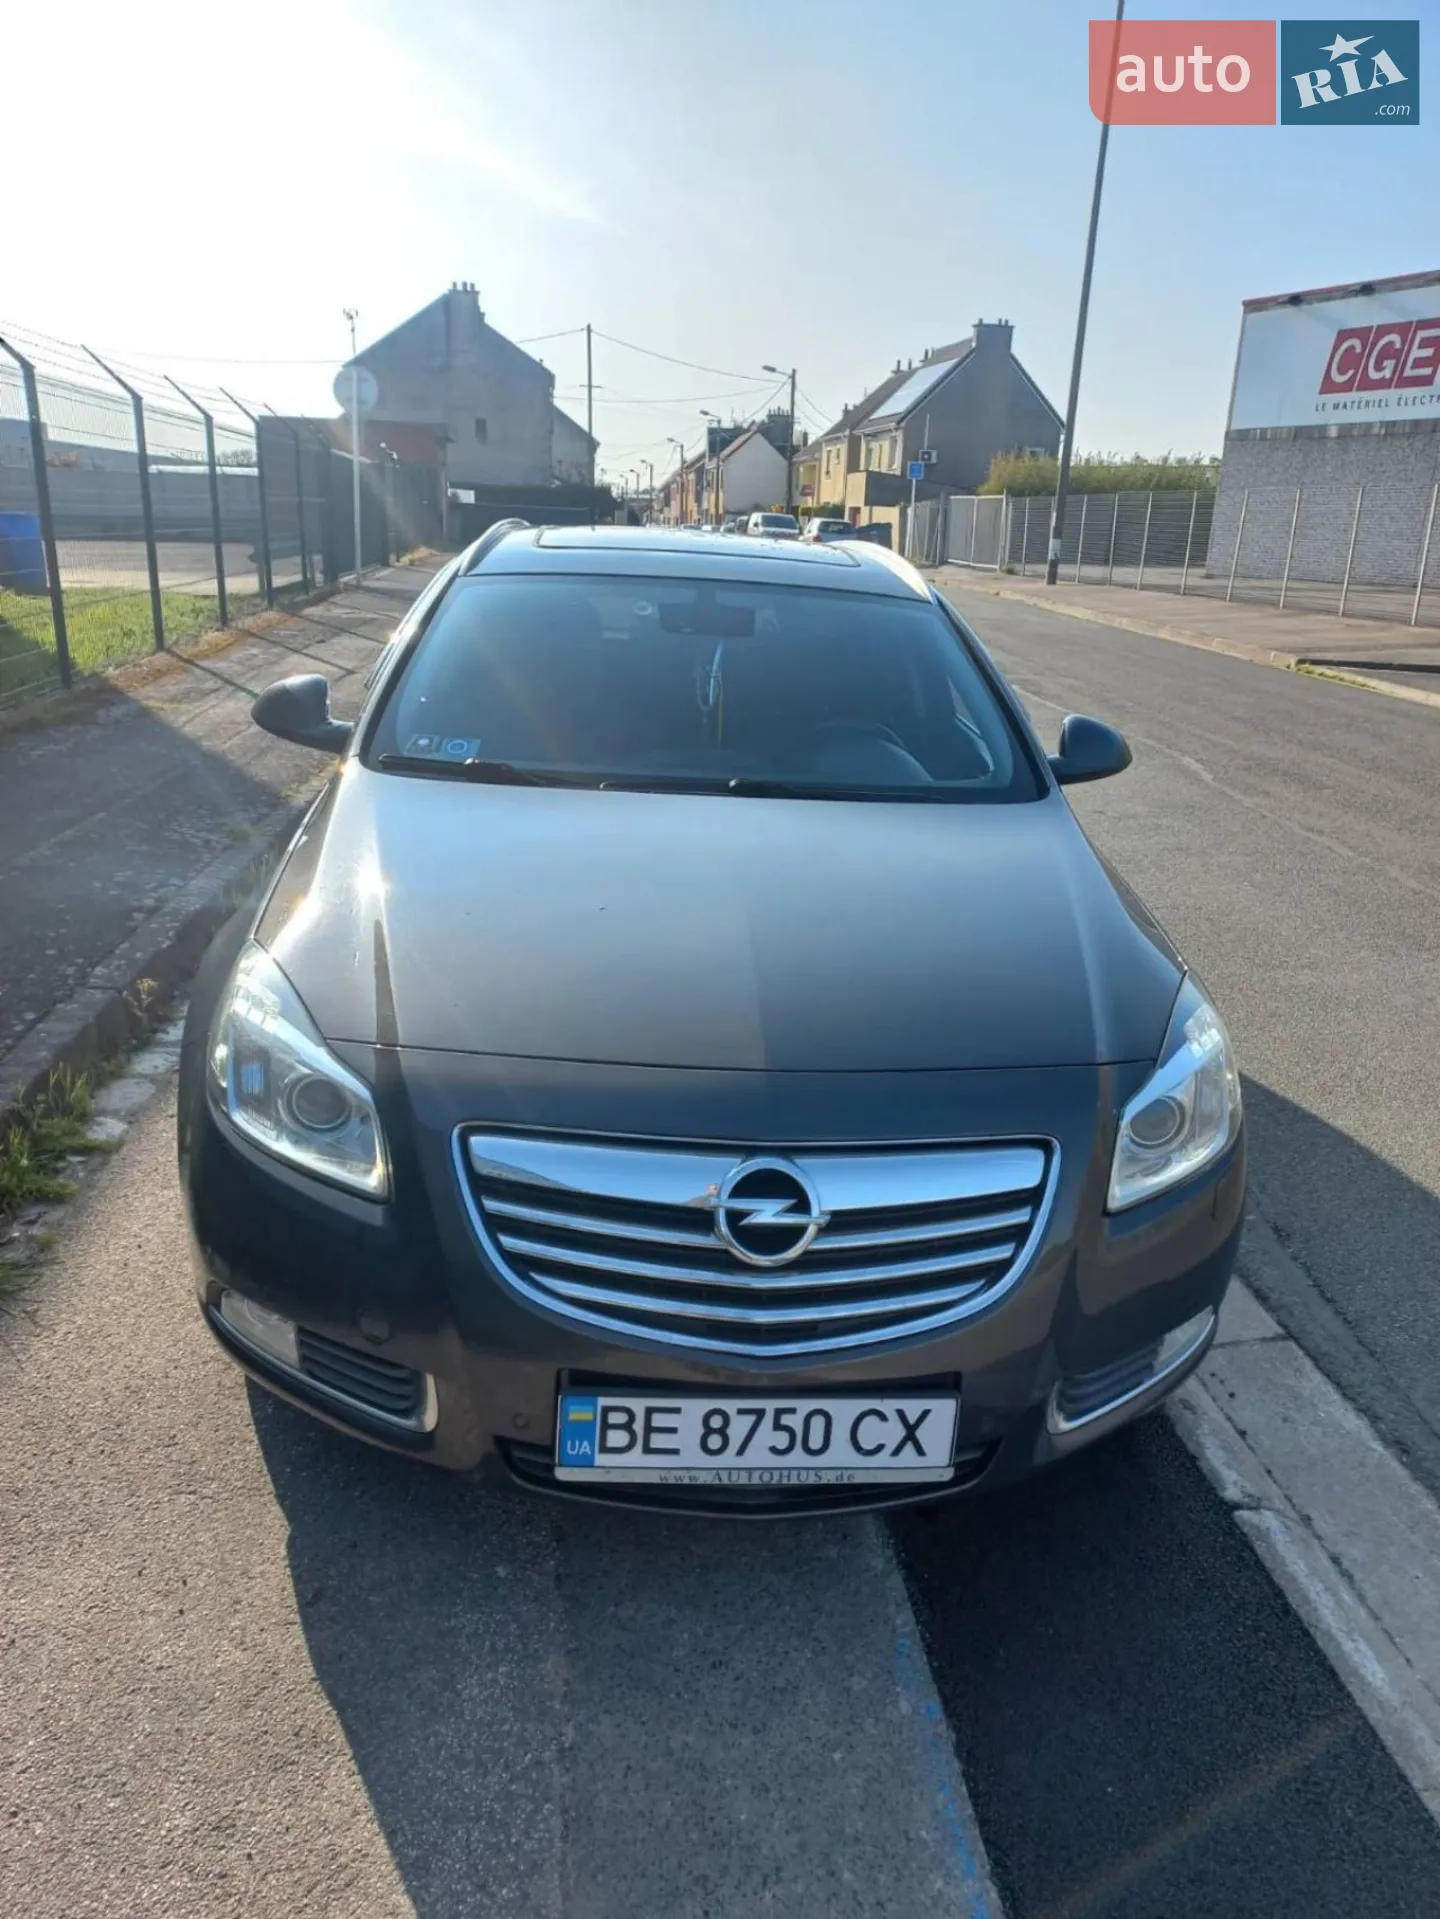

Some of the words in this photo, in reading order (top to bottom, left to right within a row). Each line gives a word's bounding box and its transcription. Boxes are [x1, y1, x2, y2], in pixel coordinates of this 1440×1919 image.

[1330, 328, 1440, 383] CGE
[1315, 402, 1327, 412] LE
[1332, 395, 1390, 411] MATÉRIEL
[567, 1439, 592, 1455] UA
[598, 1405, 682, 1455] BE
[699, 1407, 833, 1457] 8750
[849, 1408, 933, 1457] CX
